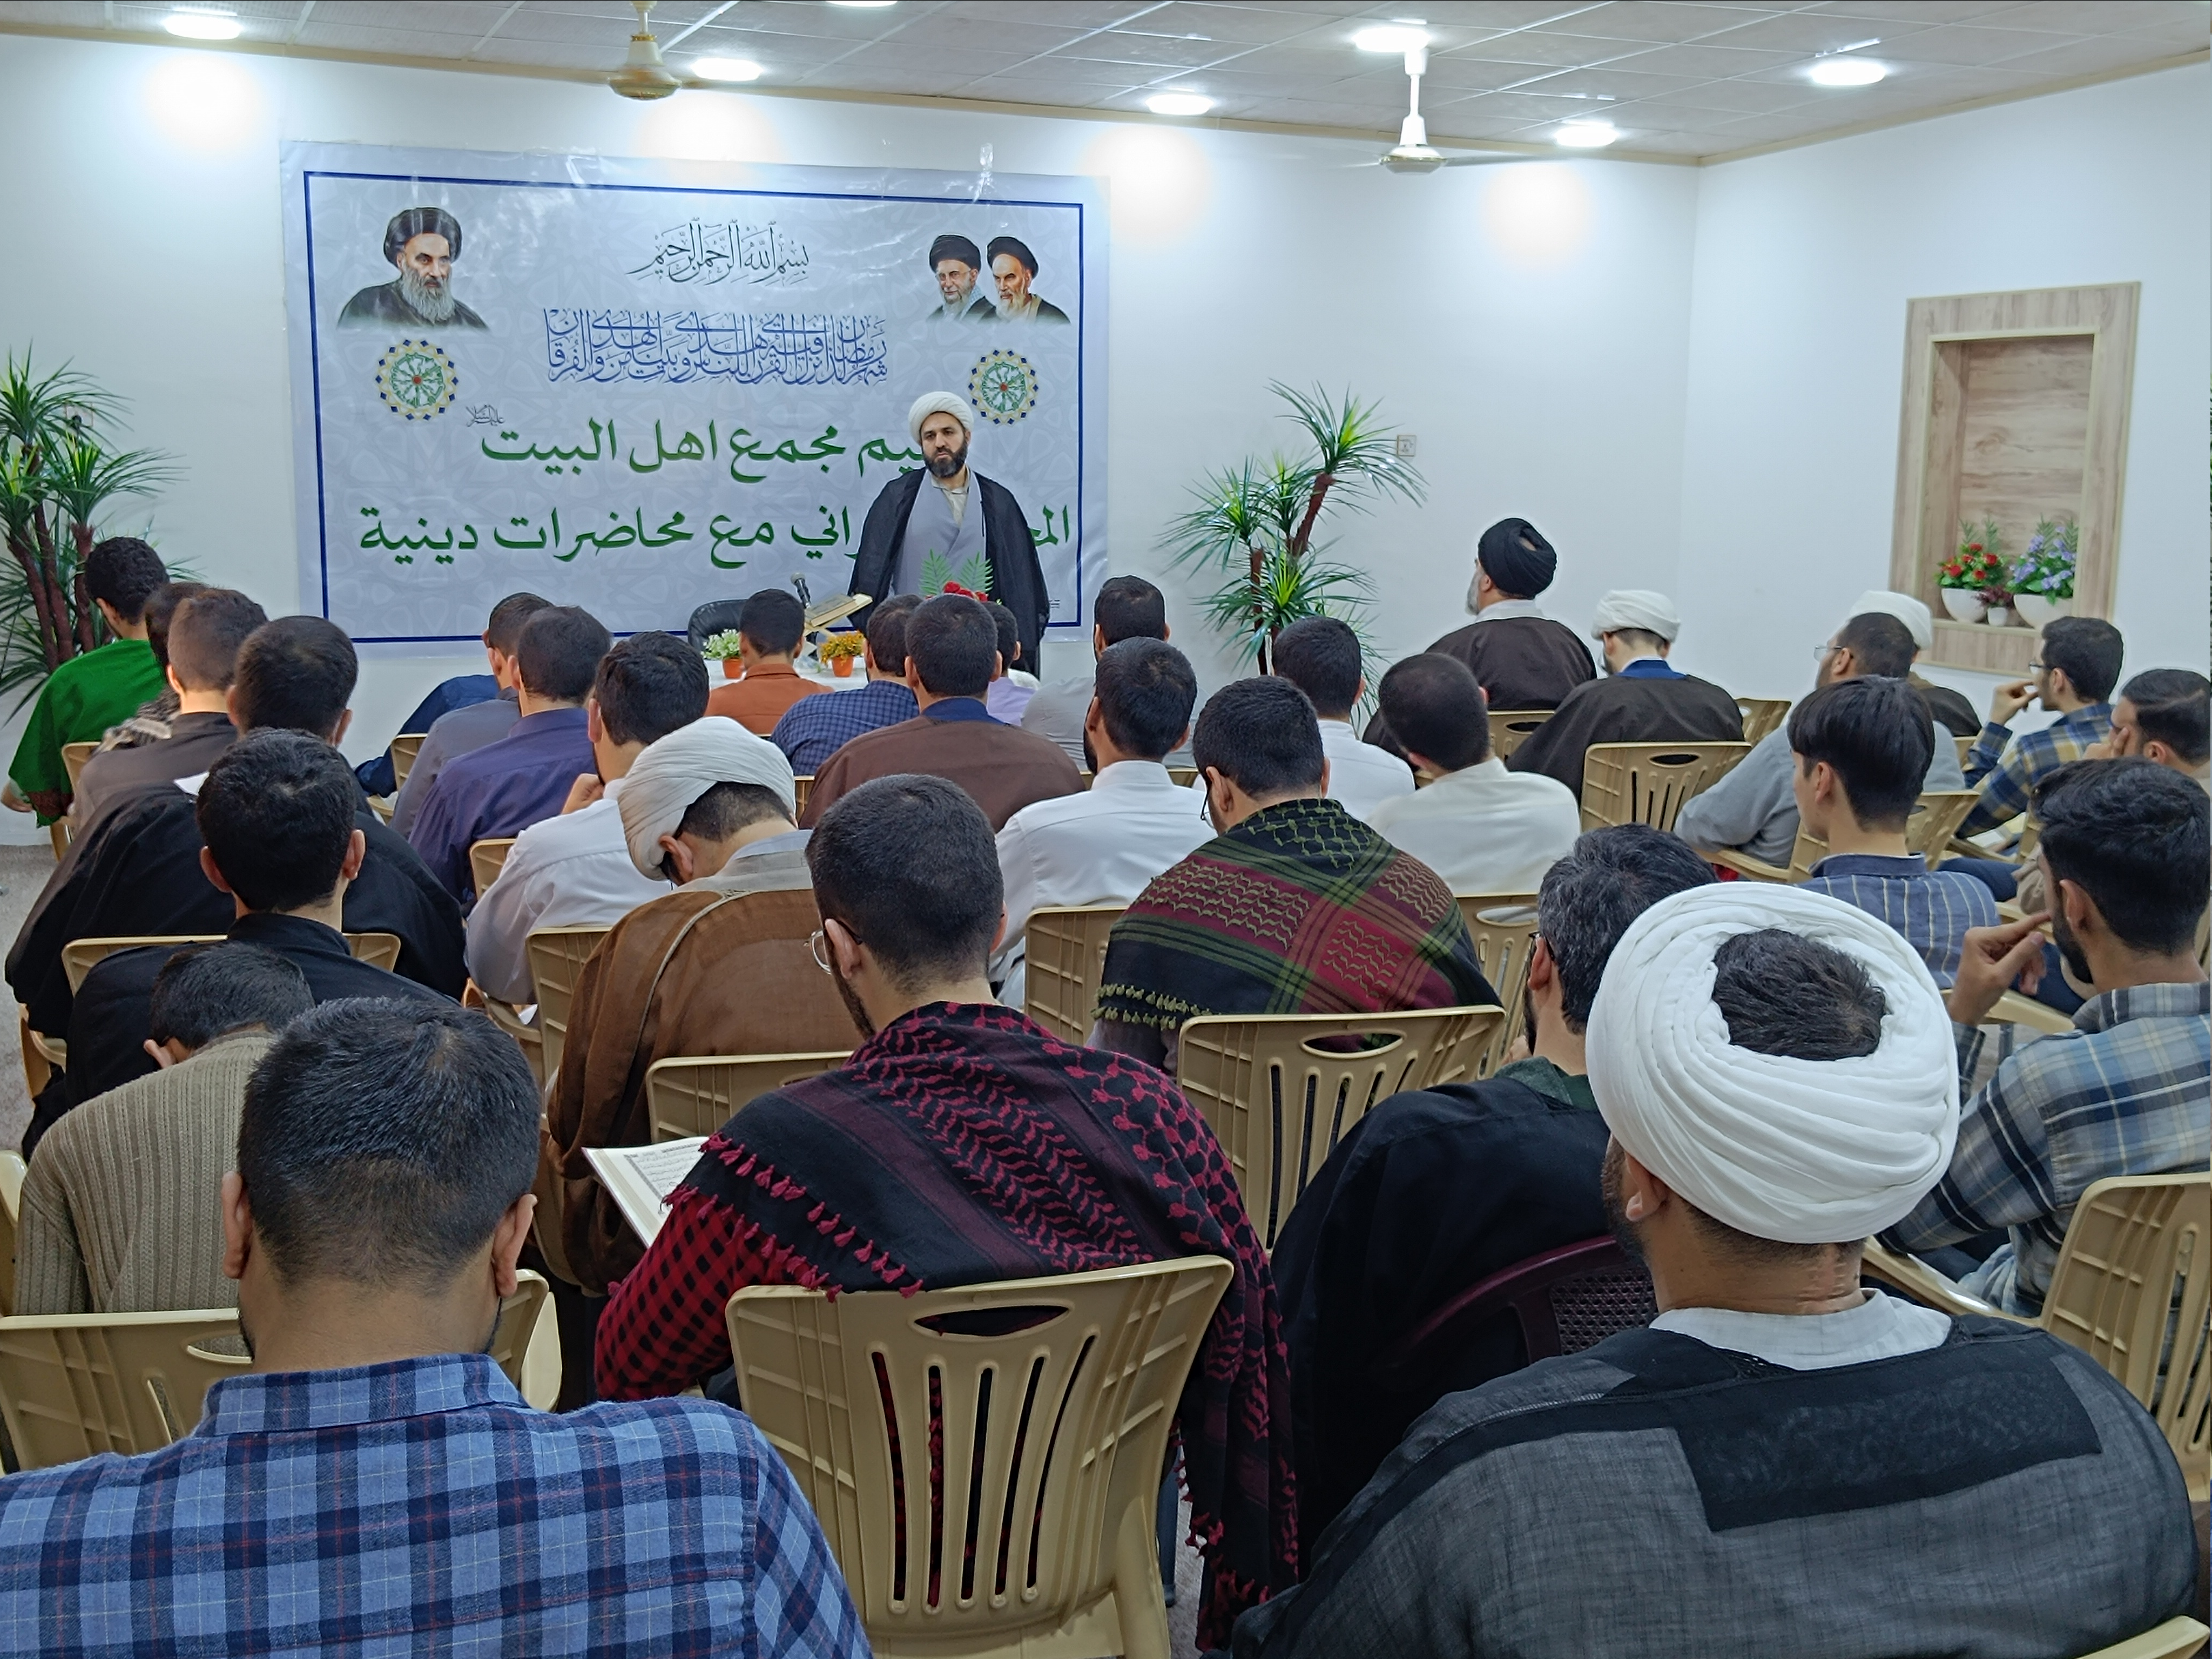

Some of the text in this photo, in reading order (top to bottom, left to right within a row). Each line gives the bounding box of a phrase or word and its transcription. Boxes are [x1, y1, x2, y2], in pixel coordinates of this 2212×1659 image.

[481, 416, 617, 475] البيت
[629, 419, 718, 474] اهل
[730, 425, 846, 483] مجمع
[360, 507, 478, 564] دينية
[494, 507, 694, 562] محاضرات
[710, 515, 774, 569] مع
